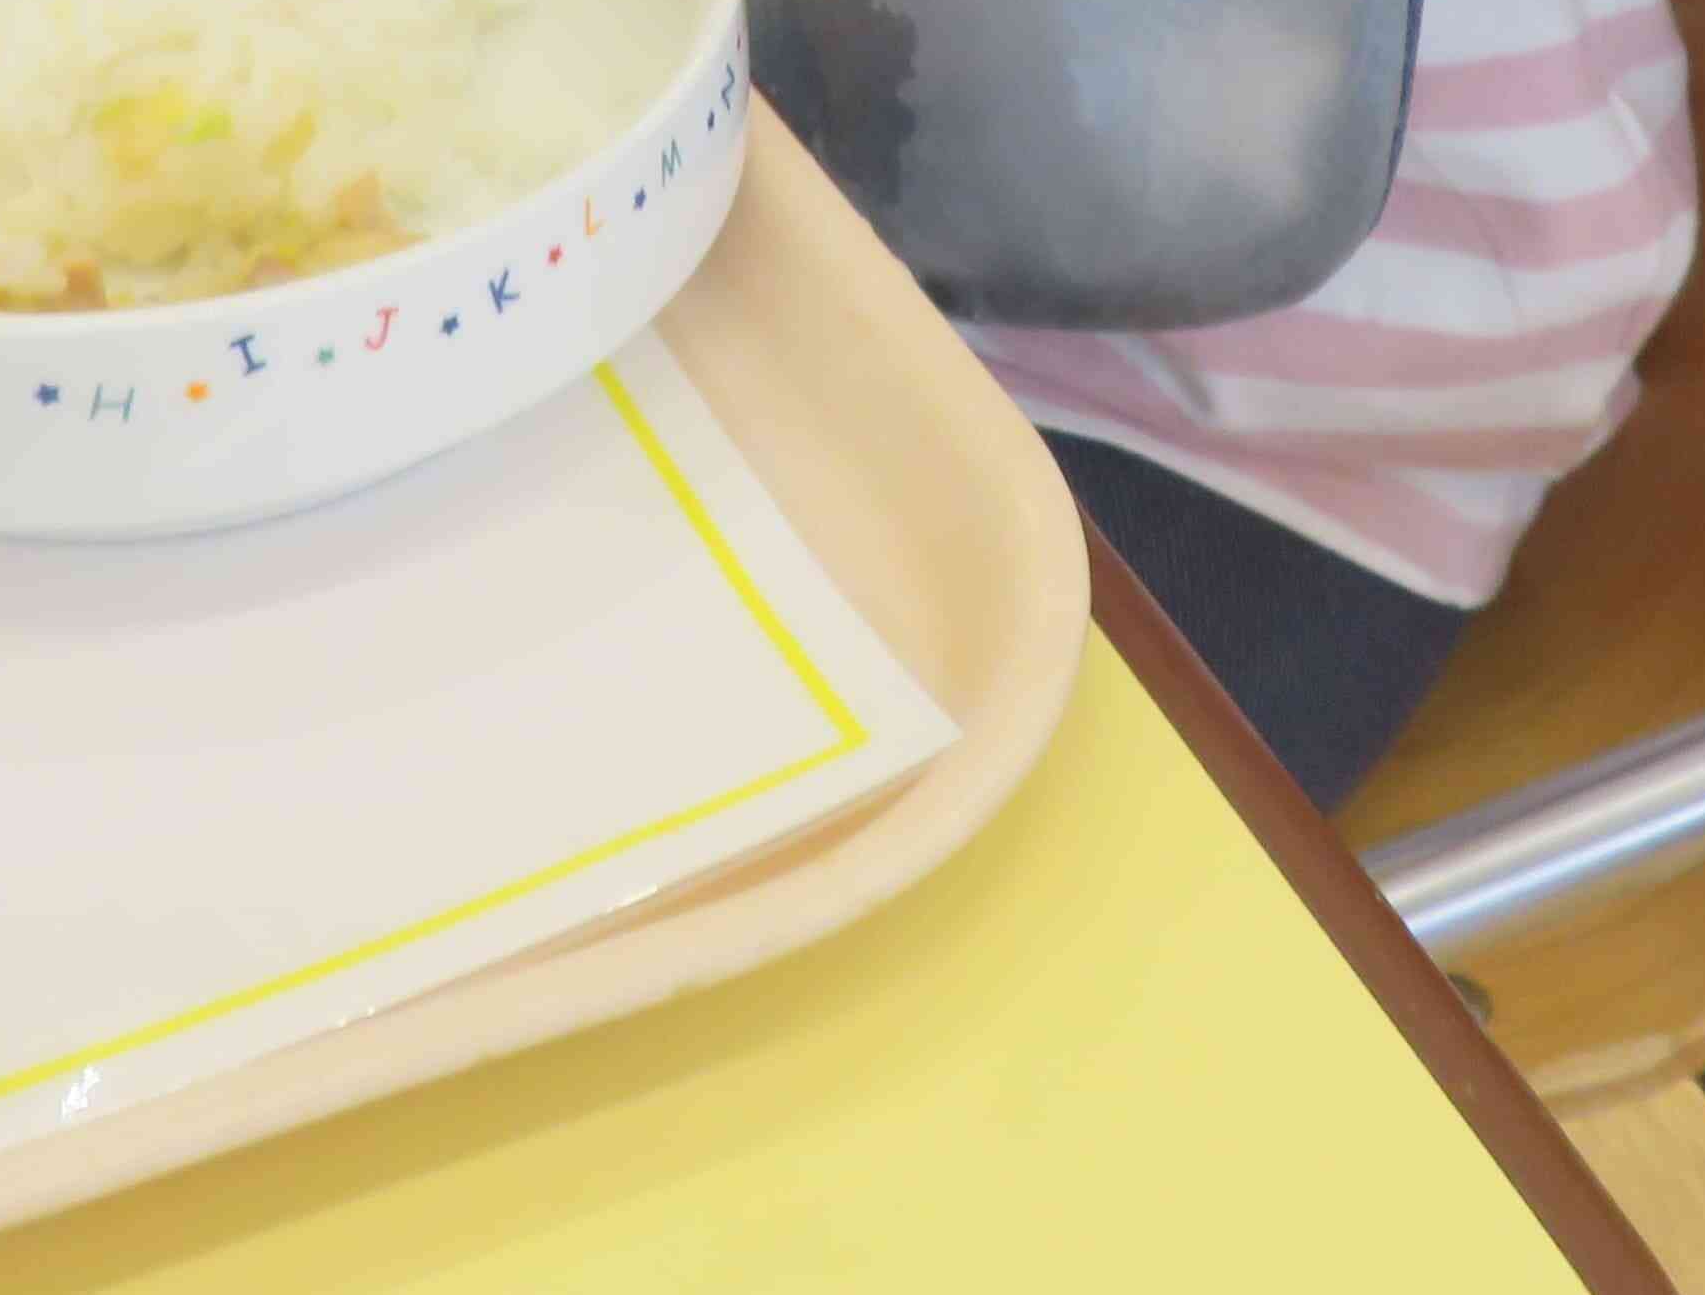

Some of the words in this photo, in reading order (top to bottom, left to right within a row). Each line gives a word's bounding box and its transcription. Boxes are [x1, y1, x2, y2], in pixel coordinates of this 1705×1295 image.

[88, 382, 135, 423] H
[364, 306, 400, 350] J
[487, 267, 521, 314] K
[583, 195, 604, 238] L
